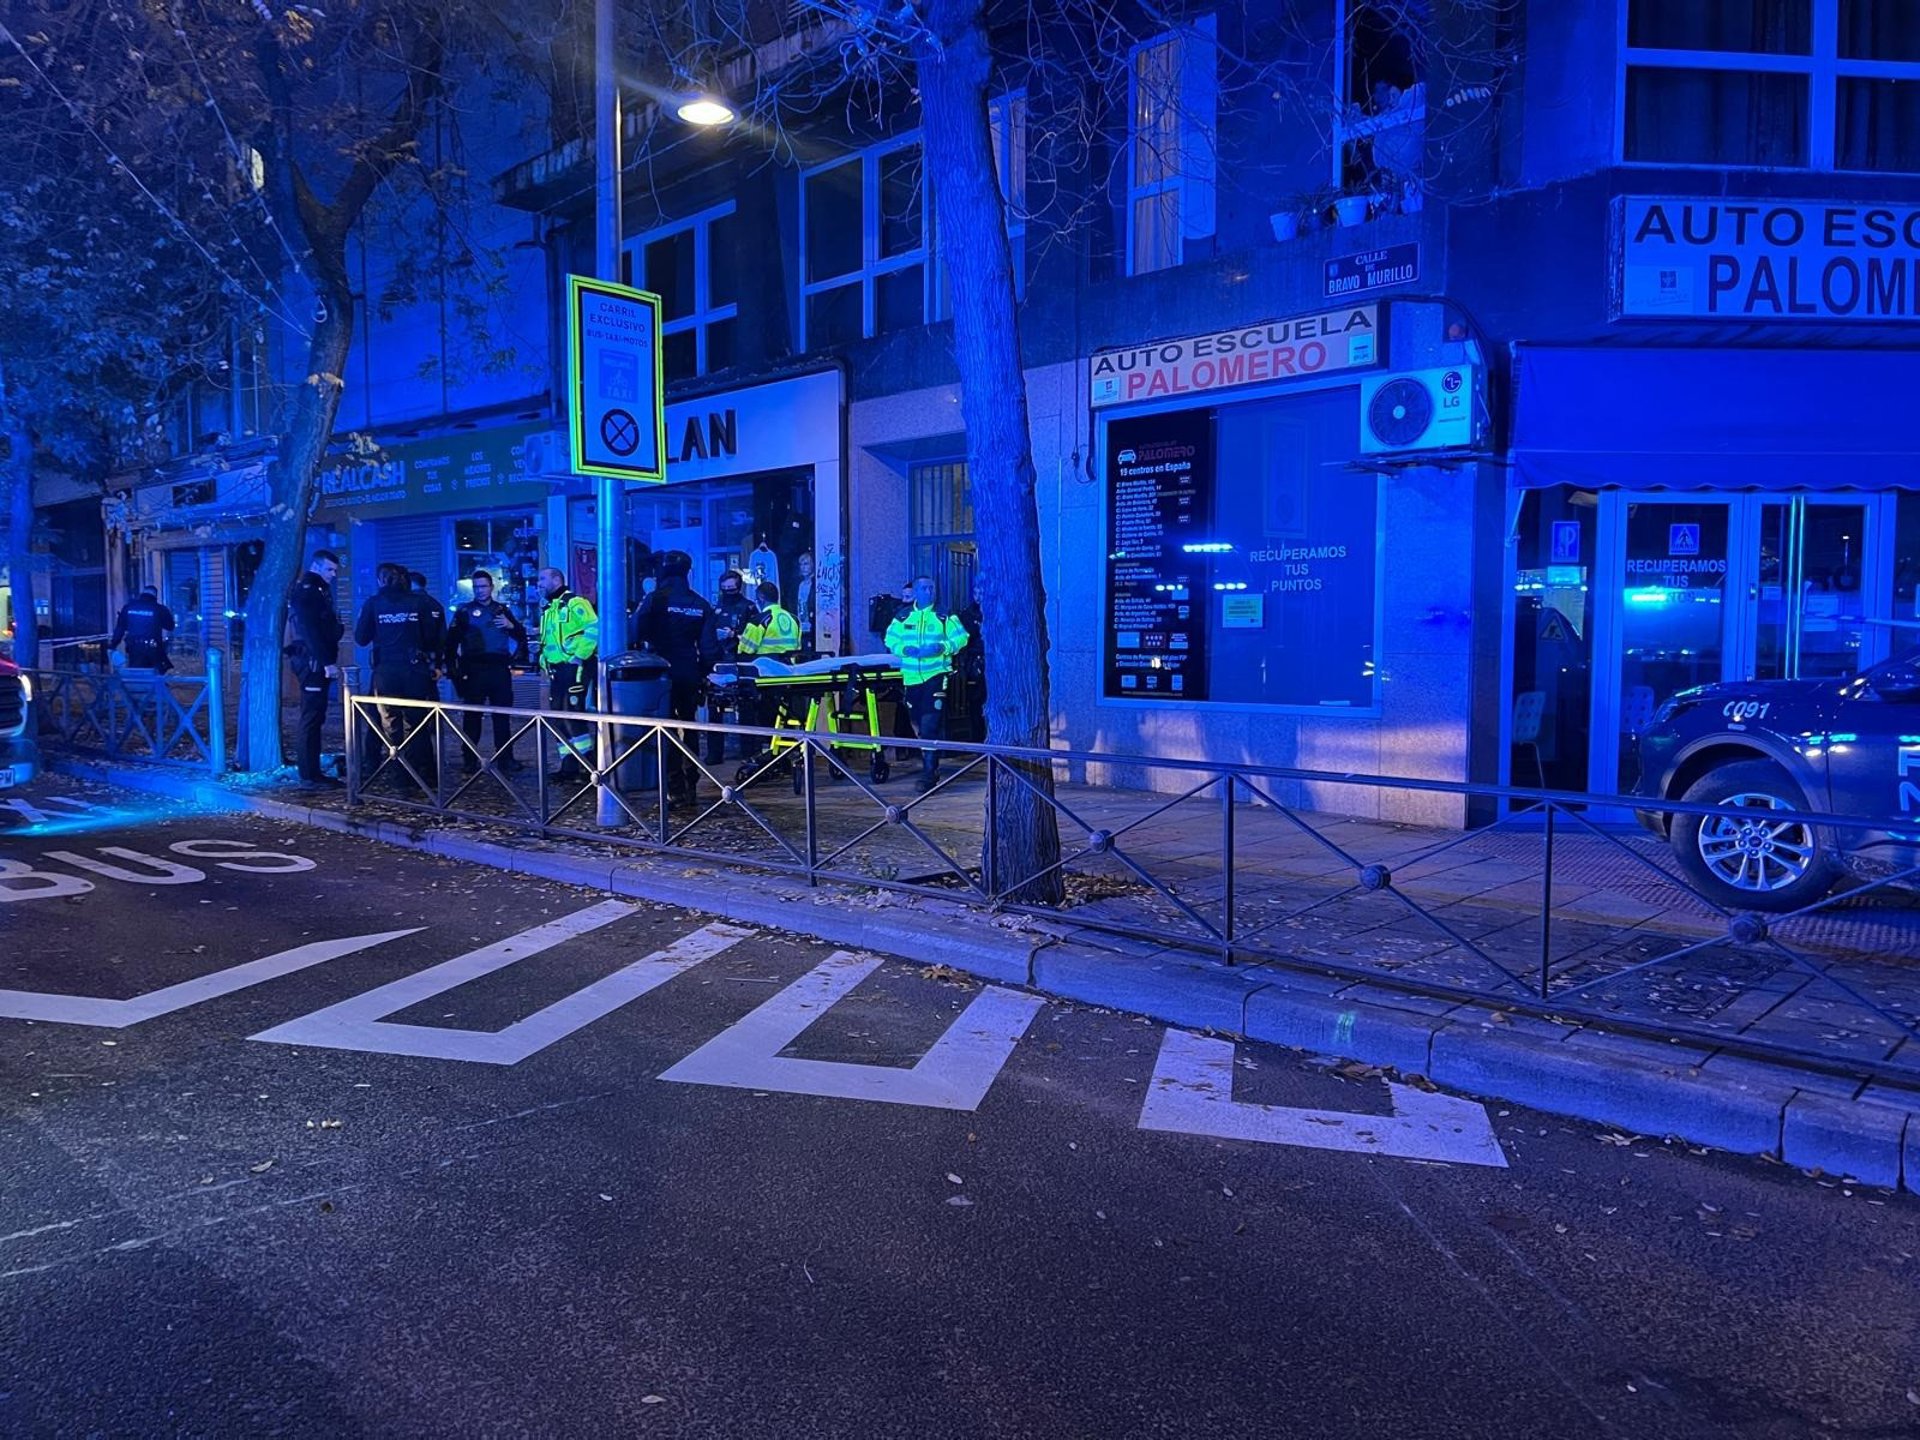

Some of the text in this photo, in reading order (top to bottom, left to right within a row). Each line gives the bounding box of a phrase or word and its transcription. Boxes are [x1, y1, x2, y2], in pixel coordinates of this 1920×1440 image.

[1633, 205, 1805, 247] AUTO
[1355, 251, 1388, 265] CALLE
[1365, 263, 1376, 273] DE
[1329, 264, 1413, 294] BRAVO MURILLO
[1708, 255, 1920, 316] PALOM
[599, 302, 637, 318] CARRIL
[590, 313, 645, 333] EXCLUSIVO
[1094, 310, 1372, 376] AUTO ESCUELA
[1127, 341, 1327, 399] PALOMERO
[1443, 396, 1461, 408] LG
[1139, 446, 1196, 461] PALOMERO
[1250, 545, 1347, 562] RECUPERAMOS
[1285, 563, 1309, 576] TUS
[1627, 559, 1726, 573] RECUPERAMOS
[1271, 578, 1322, 592] PUNTOS
[1663, 575, 1689, 588] TUS
[1723, 701, 1770, 720] C091
[0, 839, 317, 903] BUS
